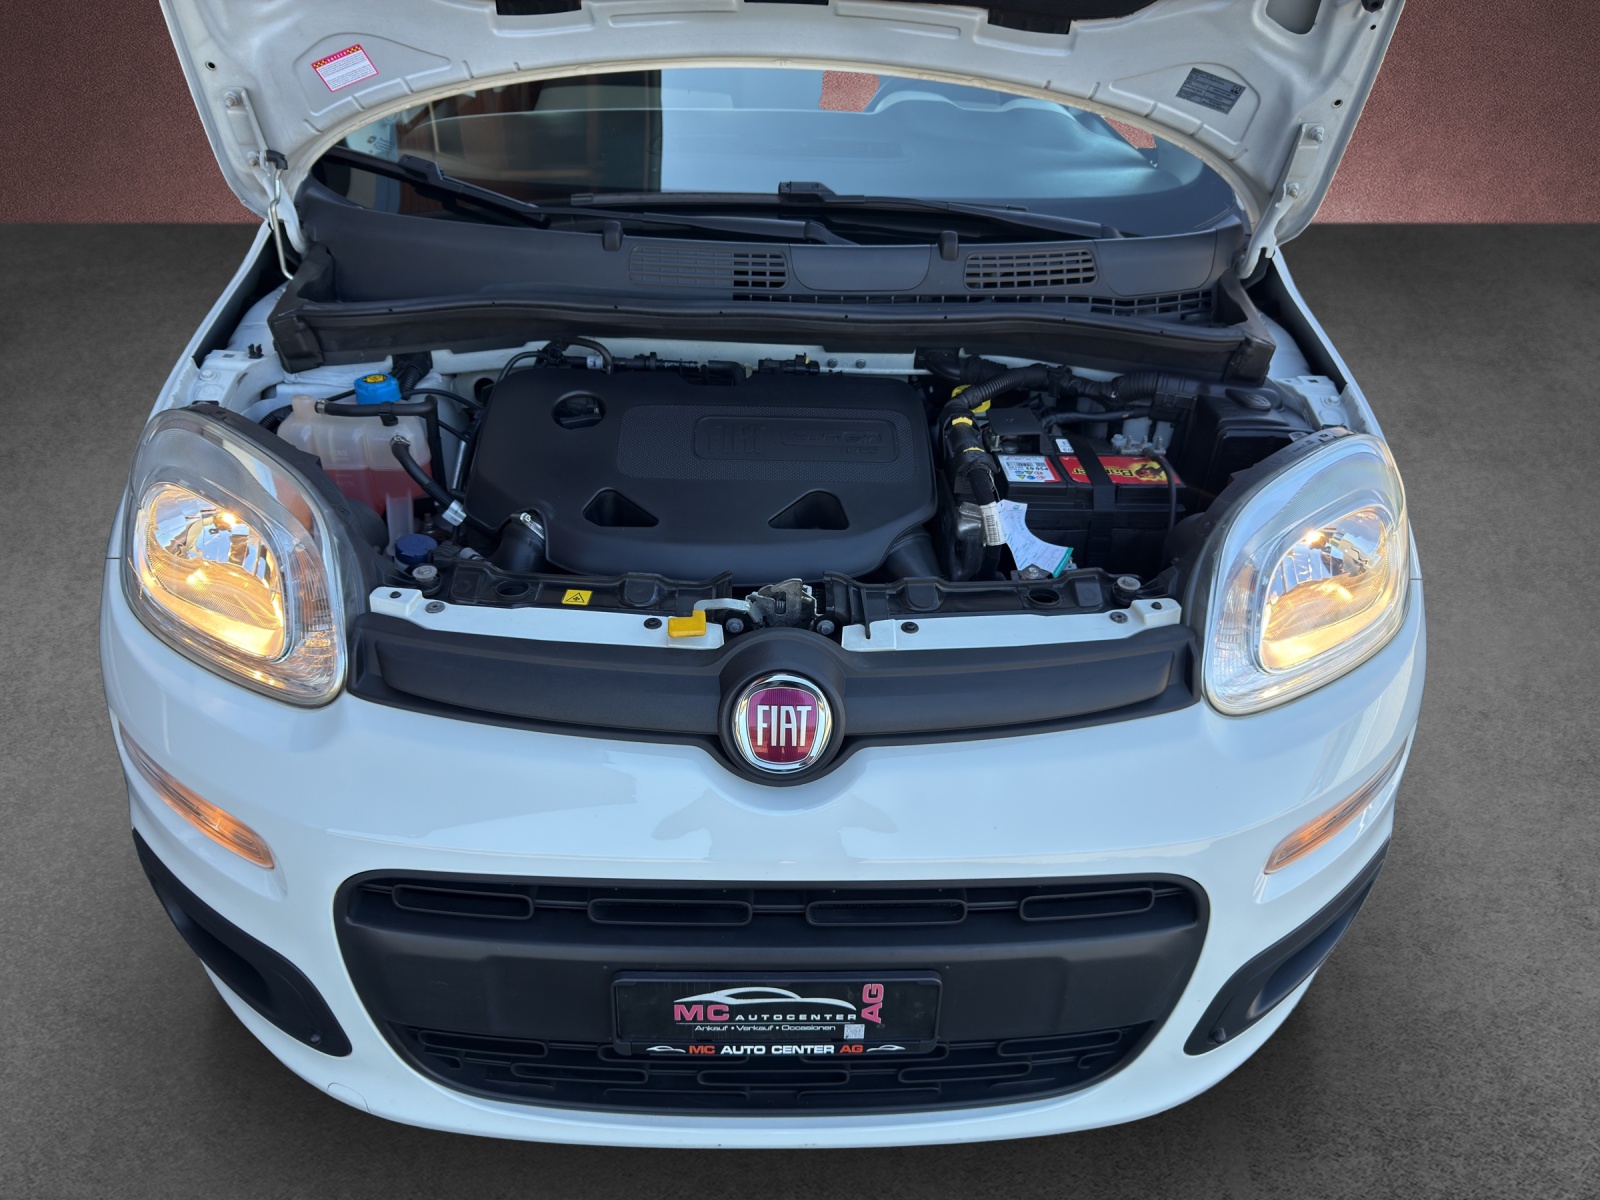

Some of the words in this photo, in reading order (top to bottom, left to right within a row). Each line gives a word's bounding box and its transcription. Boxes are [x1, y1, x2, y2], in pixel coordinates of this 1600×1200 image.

[757, 705, 812, 747] FIAT
[673, 1004, 730, 1021] MC
[861, 983, 884, 1024] AG
[688, 1045, 716, 1055] MC
[720, 1045, 766, 1055] AUTO
[771, 1045, 835, 1055] CENTER
[839, 1044, 864, 1054] AG
